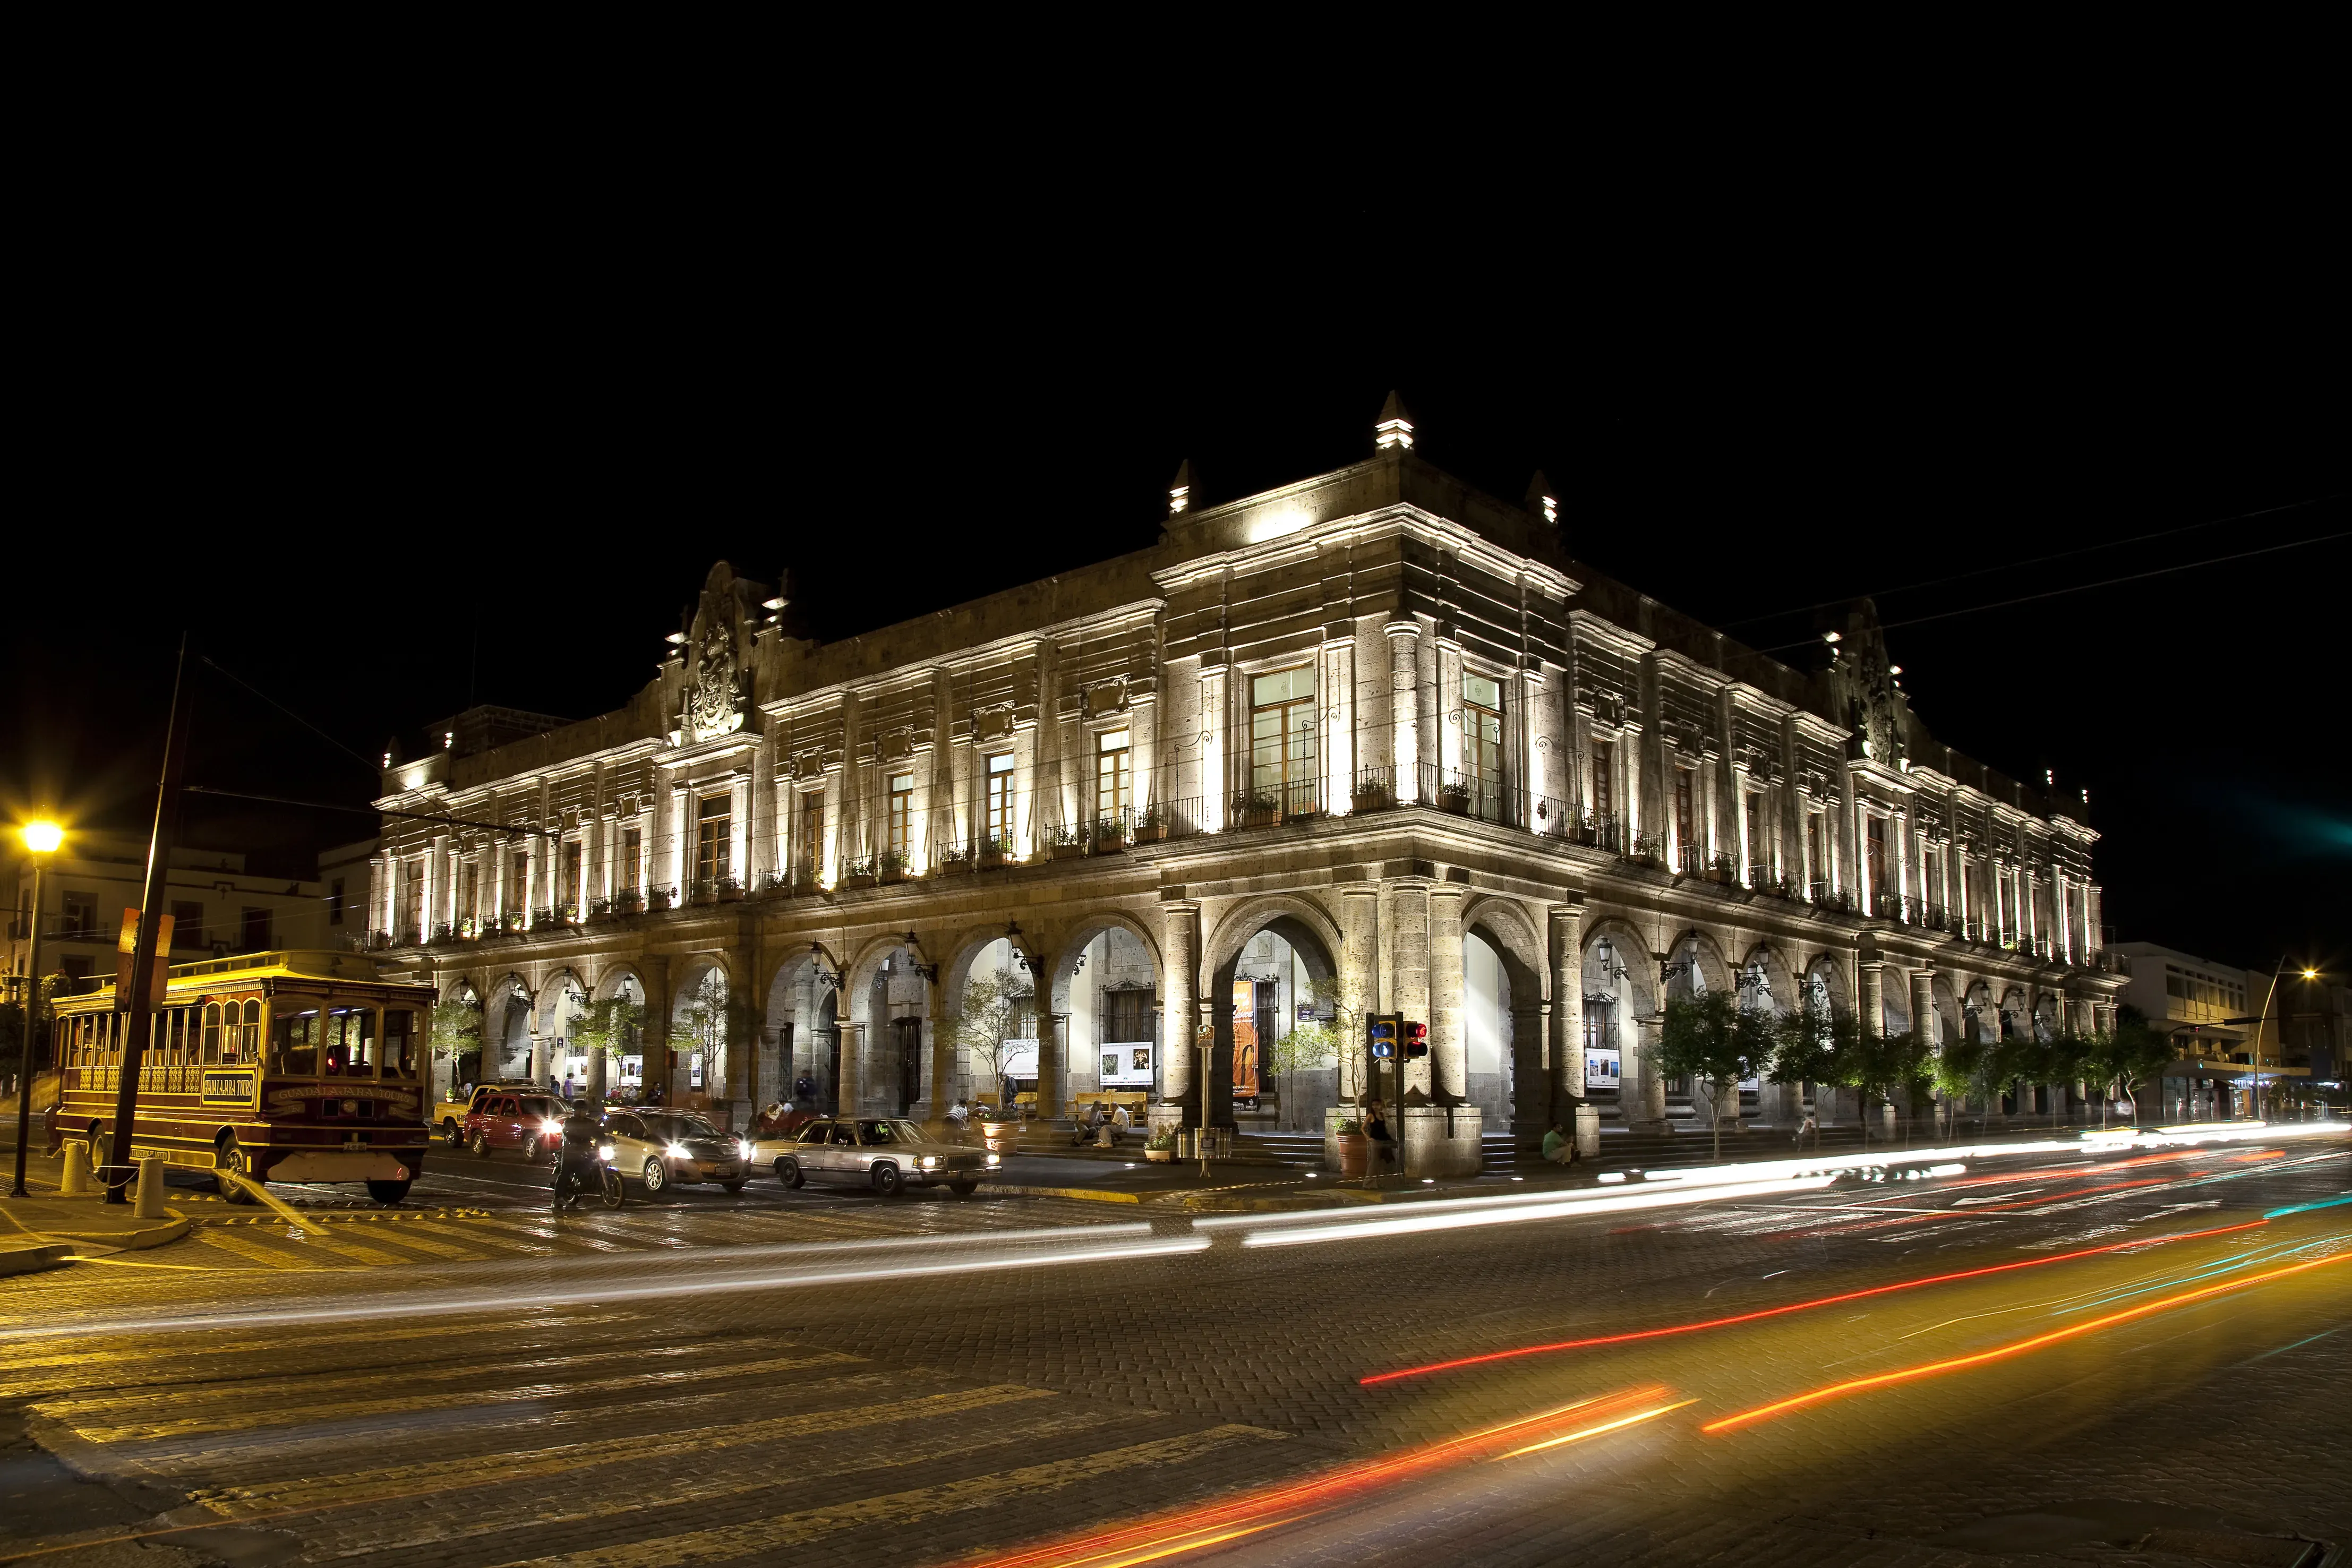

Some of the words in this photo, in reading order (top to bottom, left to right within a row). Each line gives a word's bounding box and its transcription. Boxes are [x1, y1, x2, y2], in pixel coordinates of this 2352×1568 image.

[204, 1079, 236, 1095] GUADALAJARA
[237, 1079, 252, 1096] TOURS
[279, 1087, 374, 1099] GUADALAJARA
[379, 1090, 410, 1103] TOURS
